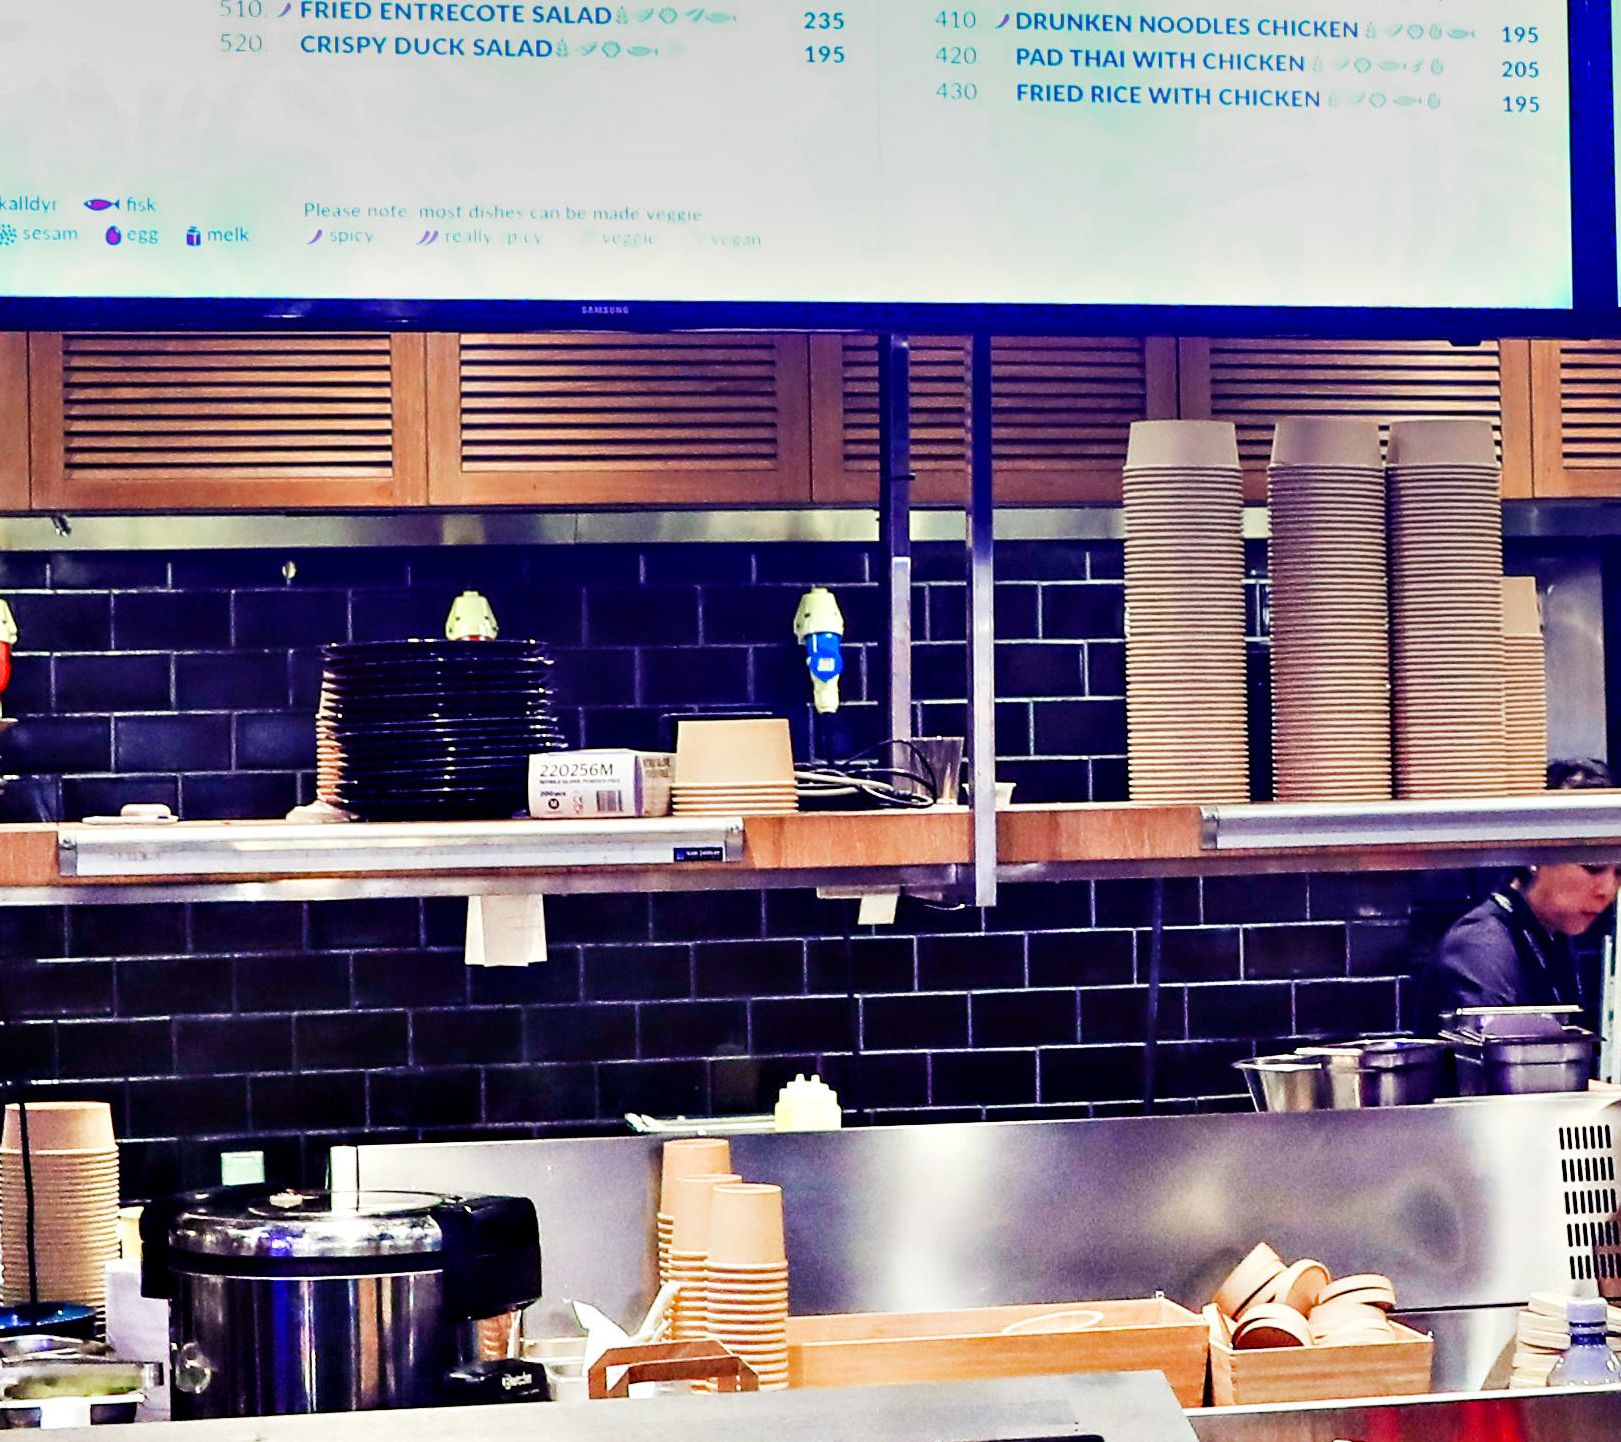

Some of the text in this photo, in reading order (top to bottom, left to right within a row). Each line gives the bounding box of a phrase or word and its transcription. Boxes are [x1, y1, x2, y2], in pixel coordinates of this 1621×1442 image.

[301, 1, 844, 29] FRIED ENTRECOTE SALAD 235
[1017, 12, 1538, 43] DRUNKEN NOODLES CHICKEN 195
[301, 36, 844, 63] CRISPY DUCK SALAD 195
[1017, 84, 1539, 112] FRIED RICE WITH CHICKEN 195
[207, 226, 250, 244] melk
[539, 762, 614, 778] 220256M
